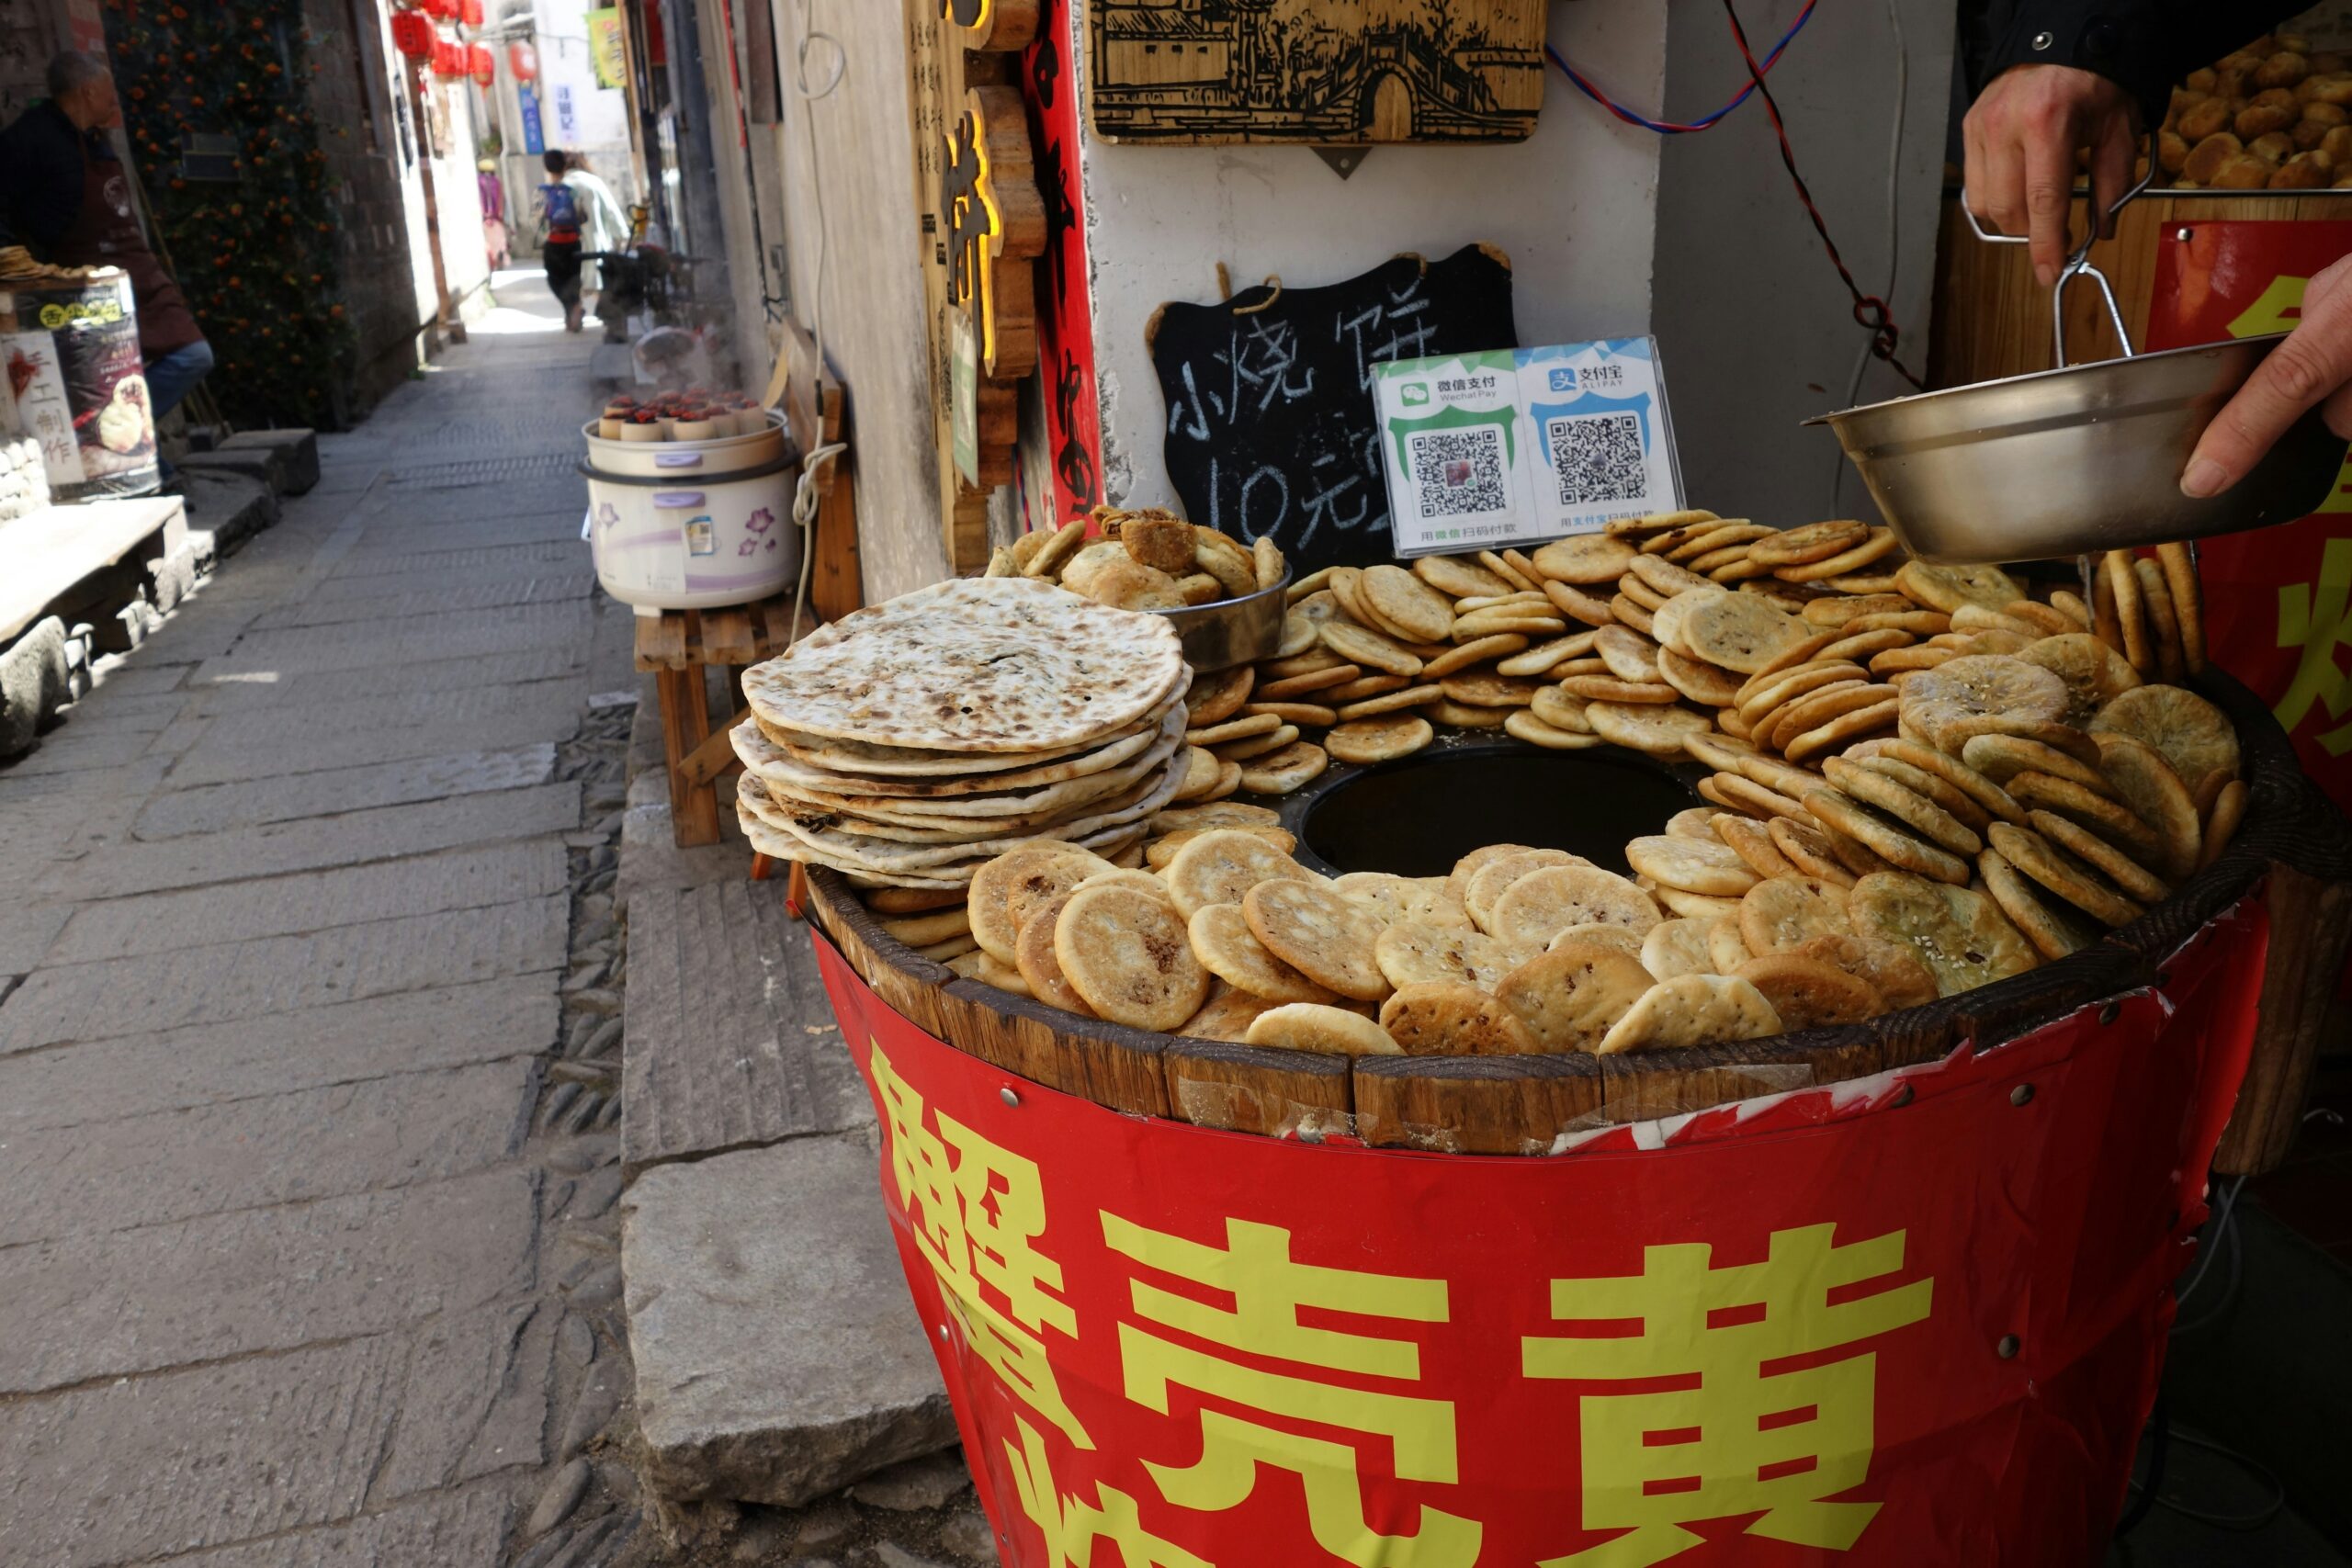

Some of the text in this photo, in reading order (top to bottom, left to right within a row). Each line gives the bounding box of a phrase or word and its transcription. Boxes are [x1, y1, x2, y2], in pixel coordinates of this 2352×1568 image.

[1169, 277, 1440, 443] 小烧饼
[1579, 365, 1623, 382] 支付宝
[1437, 376, 1497, 393] 微信支付
[1581, 379, 1623, 389] ALIPAY
[1440, 389, 1498, 402] Wechat Pay
[1420, 523, 1517, 541] 用微信扫码付款
